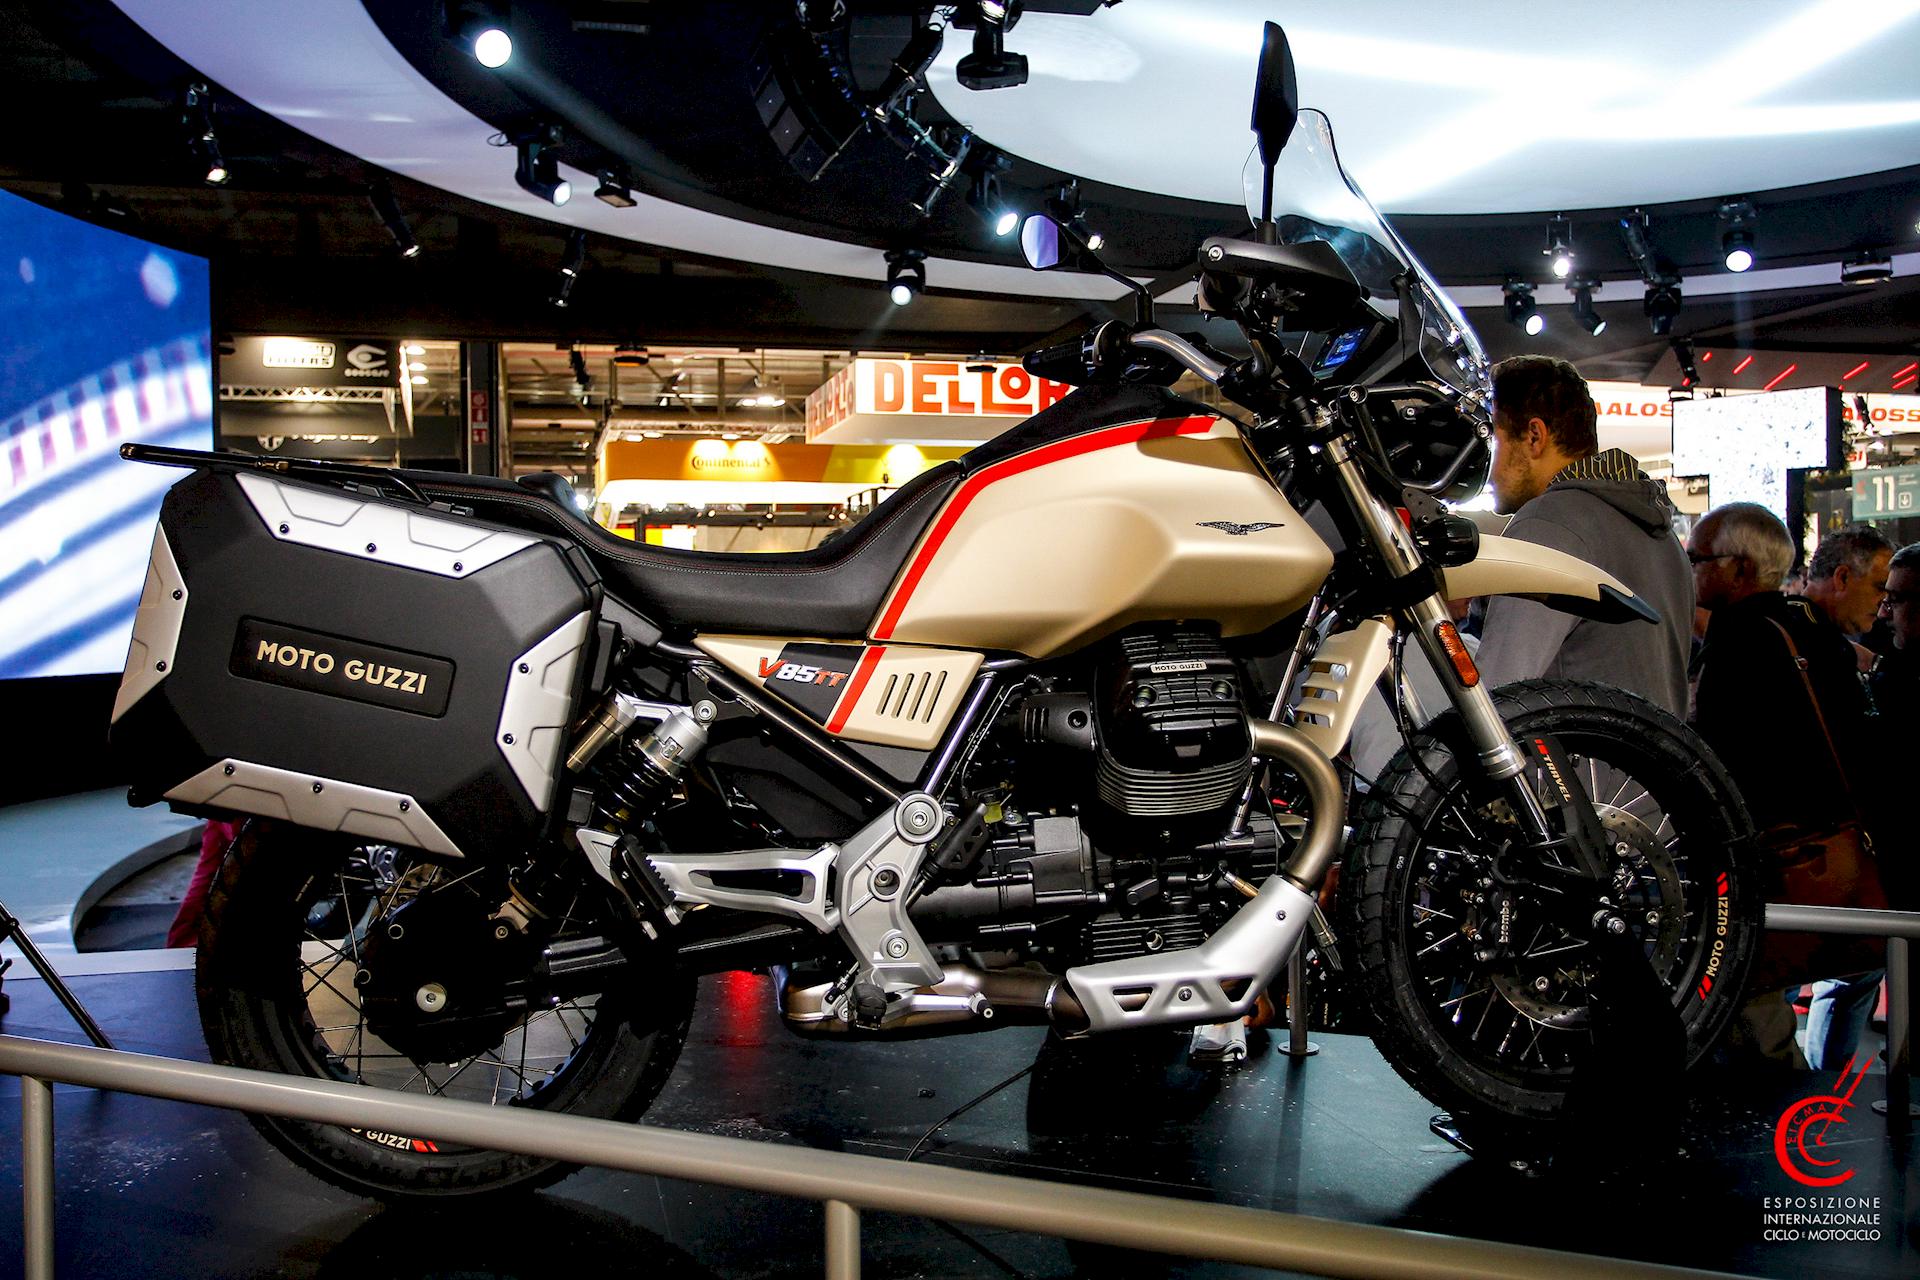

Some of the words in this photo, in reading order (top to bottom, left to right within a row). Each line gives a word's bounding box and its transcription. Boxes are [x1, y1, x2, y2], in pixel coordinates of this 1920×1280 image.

[1872, 475, 1895, 512] 11
[256, 640, 335, 675] MOTO
[344, 659, 428, 695] GUZZI
[1154, 663, 1177, 672] MOTO
[1180, 662, 1203, 670] GUZZI
[1543, 754, 1571, 802] TRAVEL
[1500, 900, 1510, 943] brembo
[1706, 940, 1724, 977] MOTO
[1717, 896, 1729, 936] GUZZI
[366, 1130, 411, 1150] GUZZI
